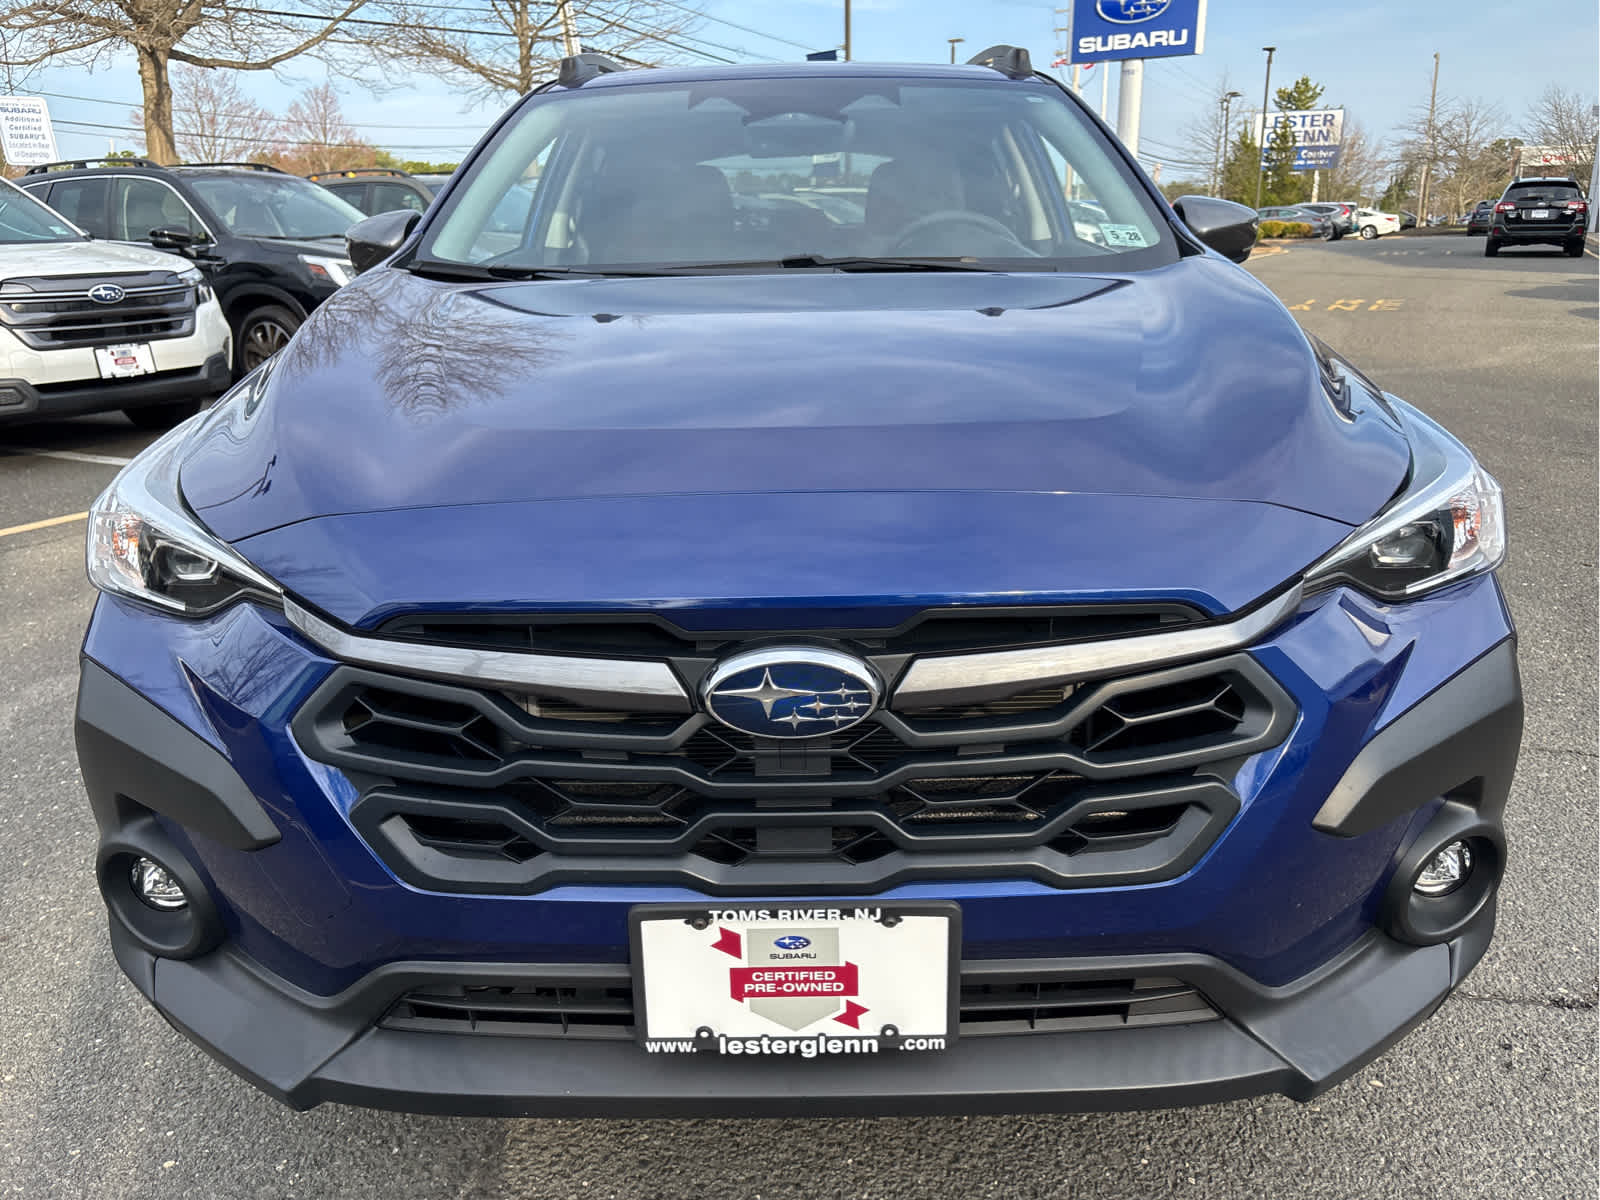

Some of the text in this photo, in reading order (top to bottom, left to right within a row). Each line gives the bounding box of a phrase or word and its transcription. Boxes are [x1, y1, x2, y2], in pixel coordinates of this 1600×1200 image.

[1078, 29, 1188, 53] SUBARU
[1266, 129, 1330, 144] GENN
[1110, 230, 1141, 241] 5 28
[708, 910, 770, 922] TOMS
[854, 908, 882, 922] NJ
[769, 952, 817, 960] SUBARU
[751, 970, 836, 981] CERTIFIED
[744, 982, 845, 992] PRE-OWNED
[645, 1034, 946, 1059] www. lesterglenn .com
